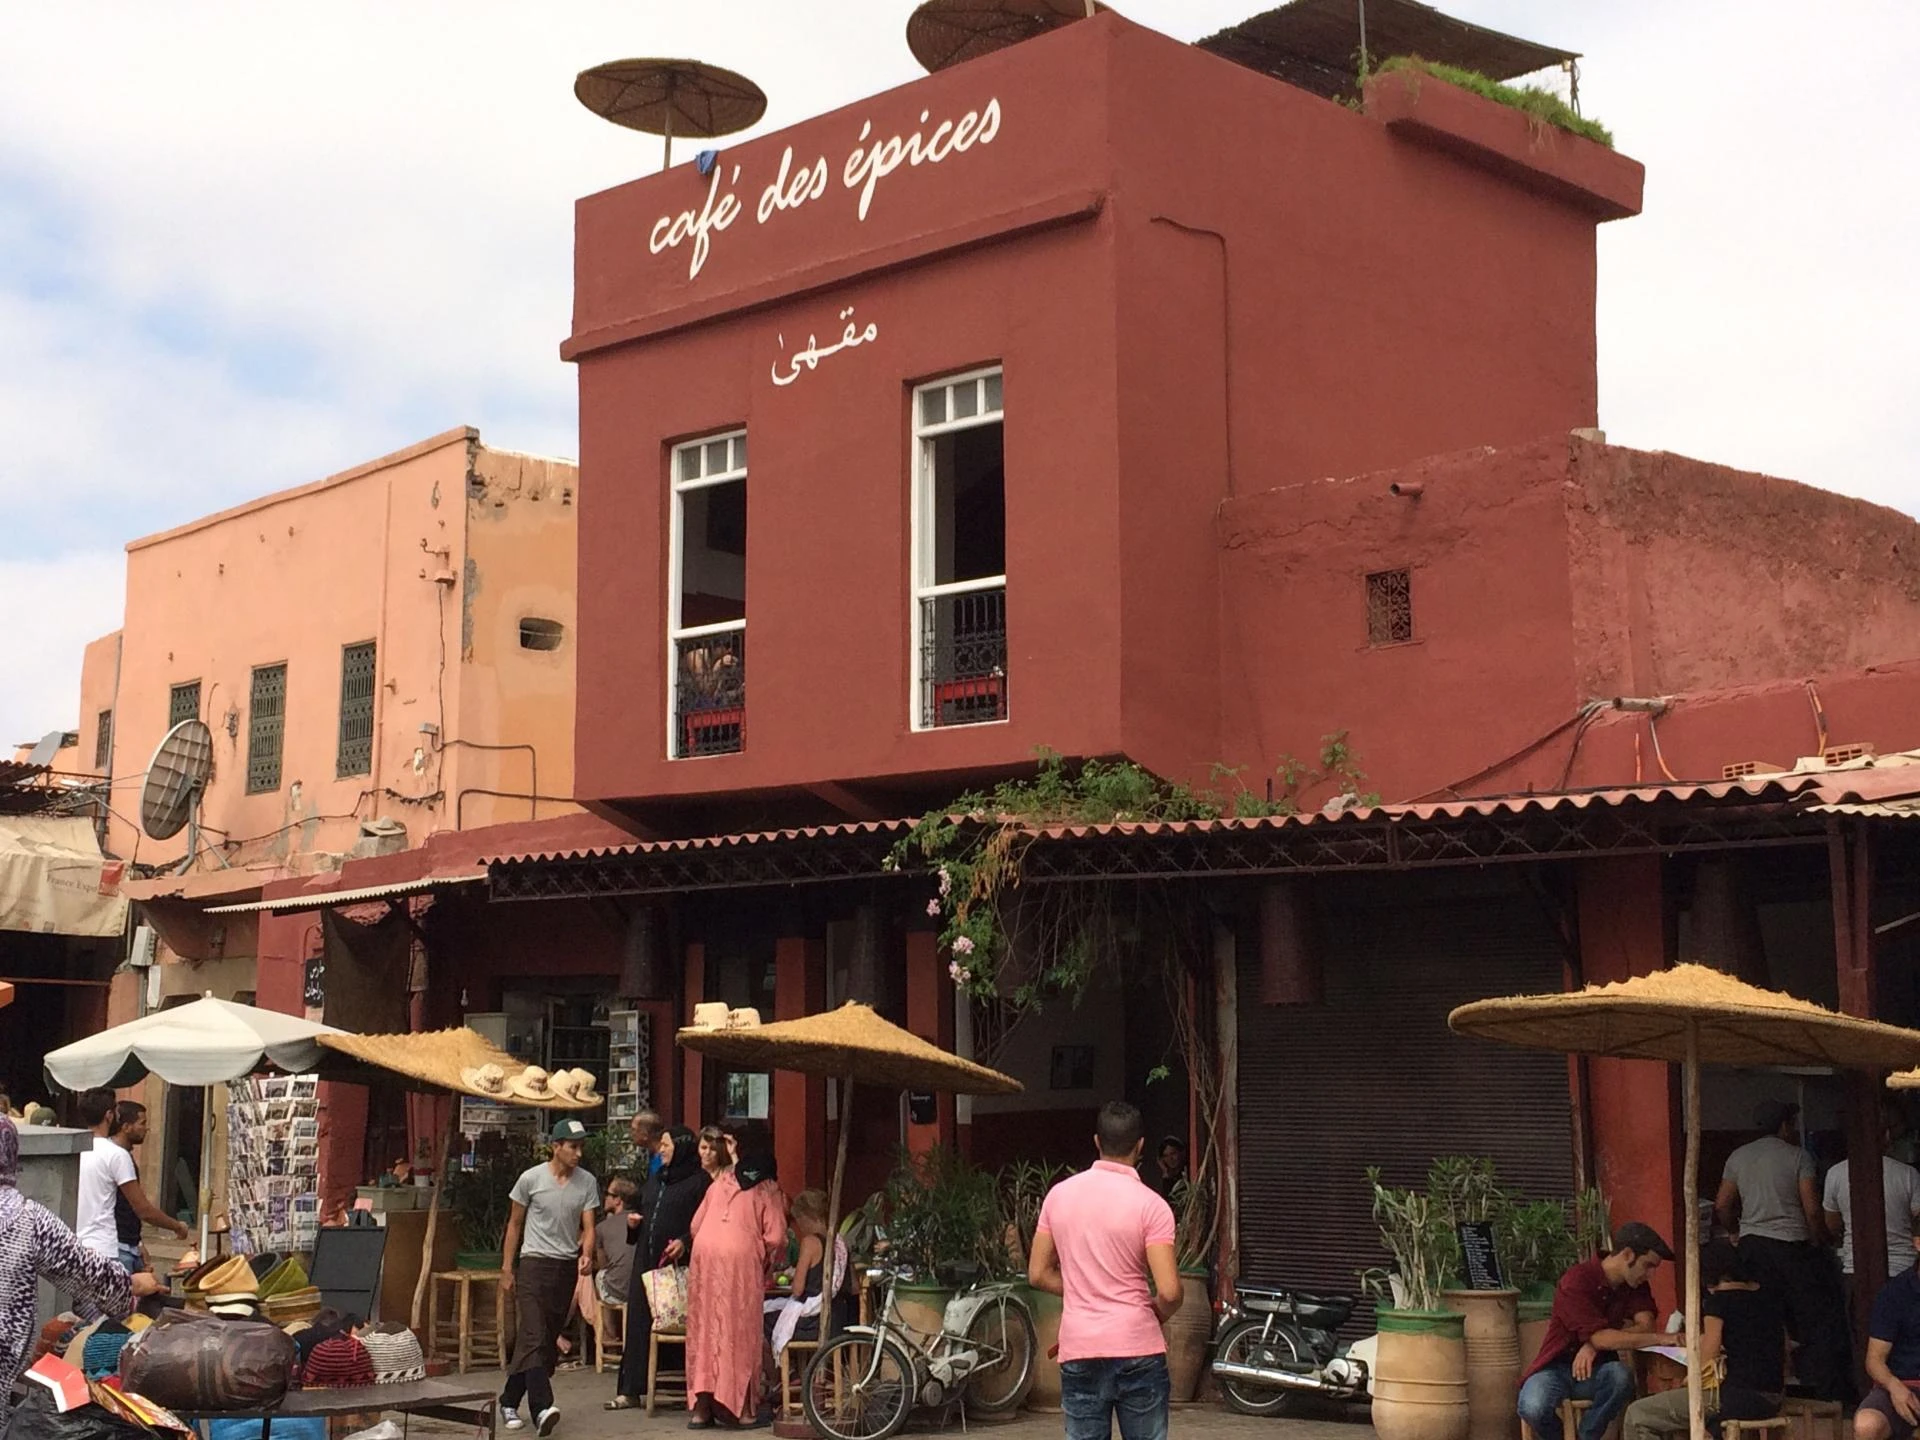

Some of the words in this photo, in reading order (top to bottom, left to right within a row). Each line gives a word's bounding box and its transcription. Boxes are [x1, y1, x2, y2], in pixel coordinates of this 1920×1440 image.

[649, 164, 742, 281] café
[756, 145, 828, 224] des
[843, 97, 1001, 222] épices
